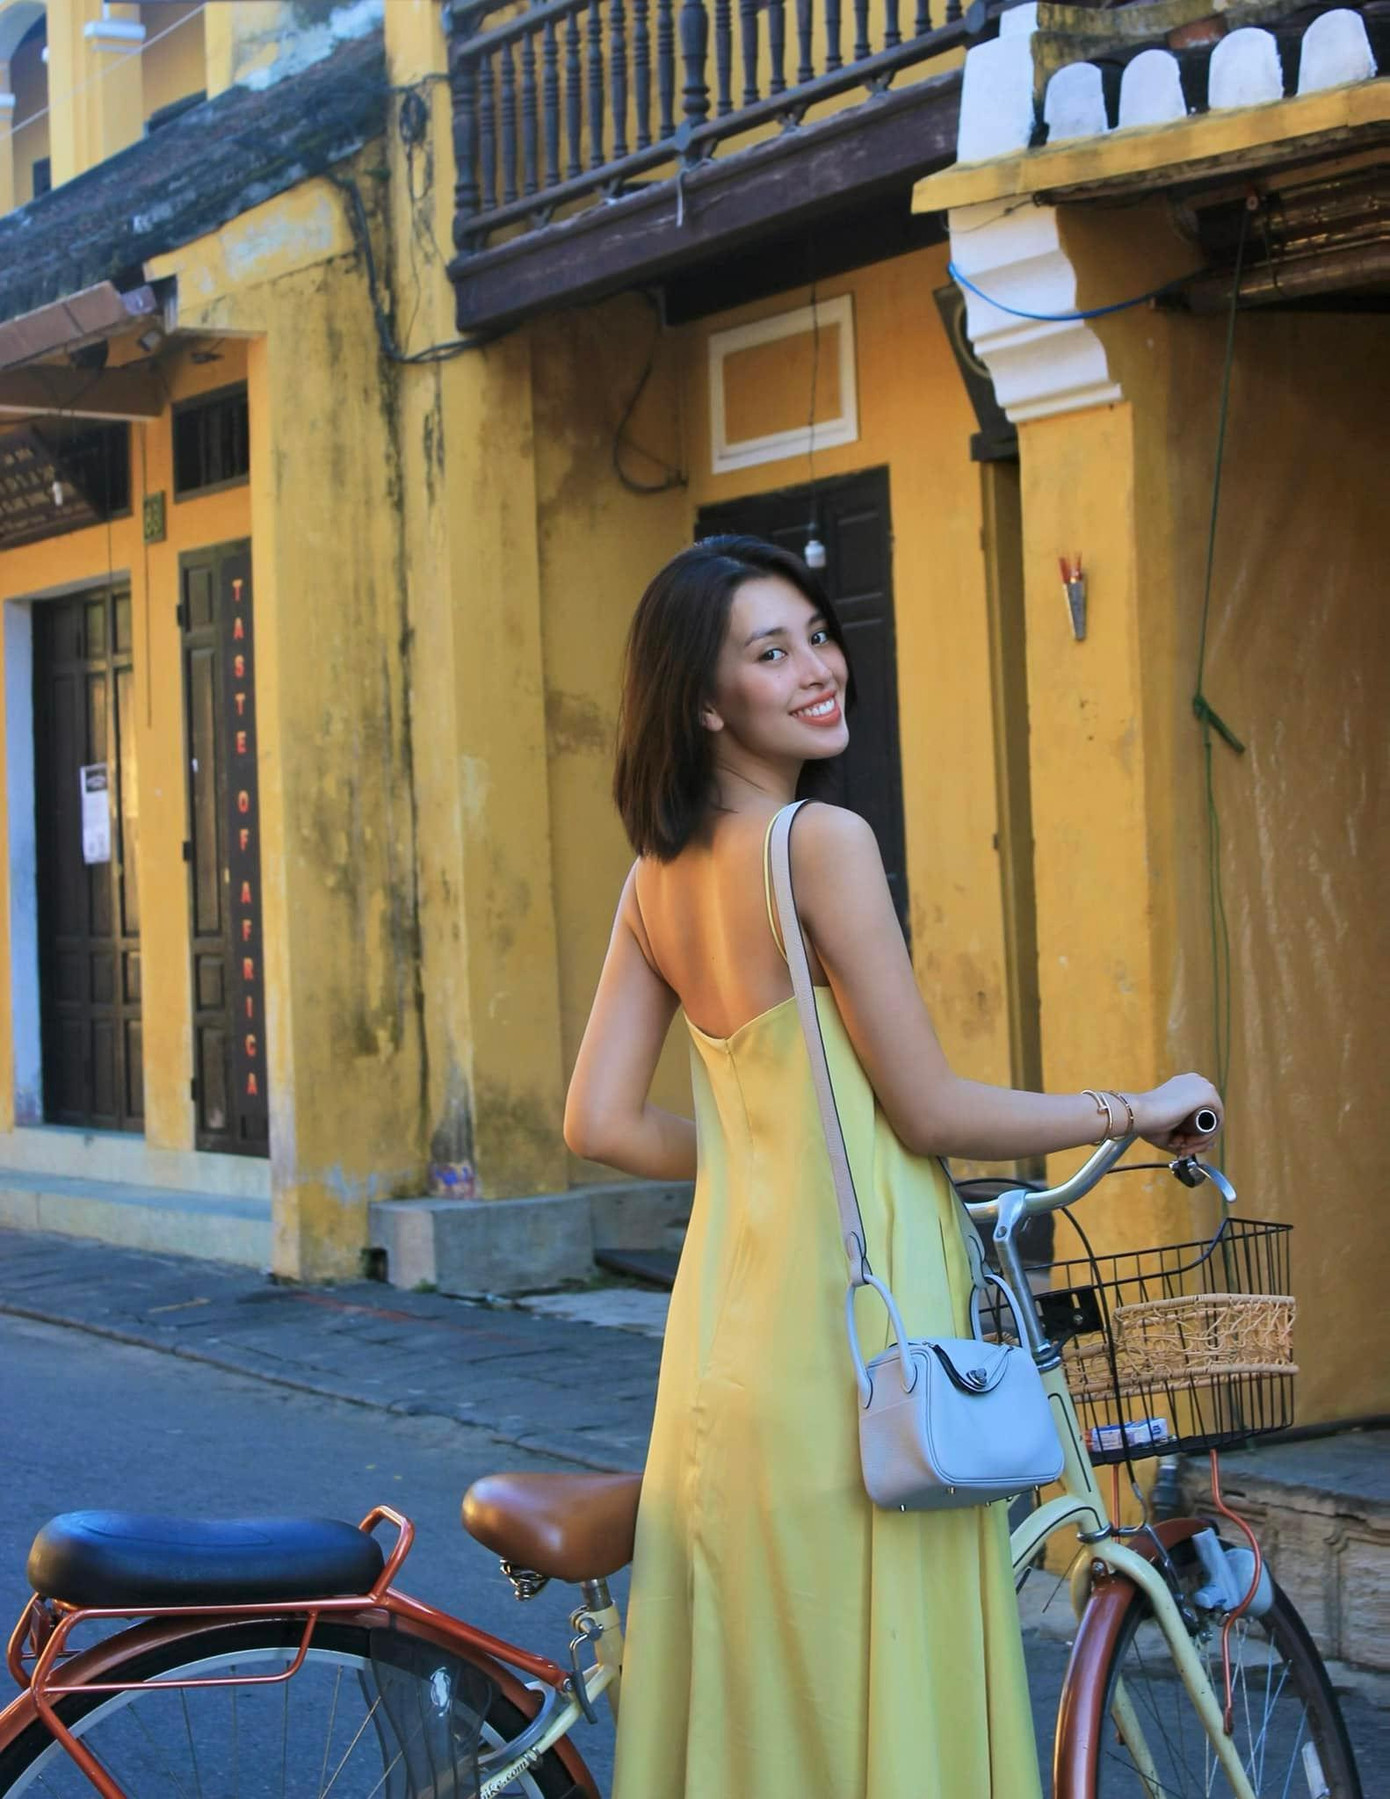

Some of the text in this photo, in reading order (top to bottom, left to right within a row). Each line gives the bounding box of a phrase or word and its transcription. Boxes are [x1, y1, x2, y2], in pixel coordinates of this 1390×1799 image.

[232, 579, 258, 1095] TASTE OF AFRICA
